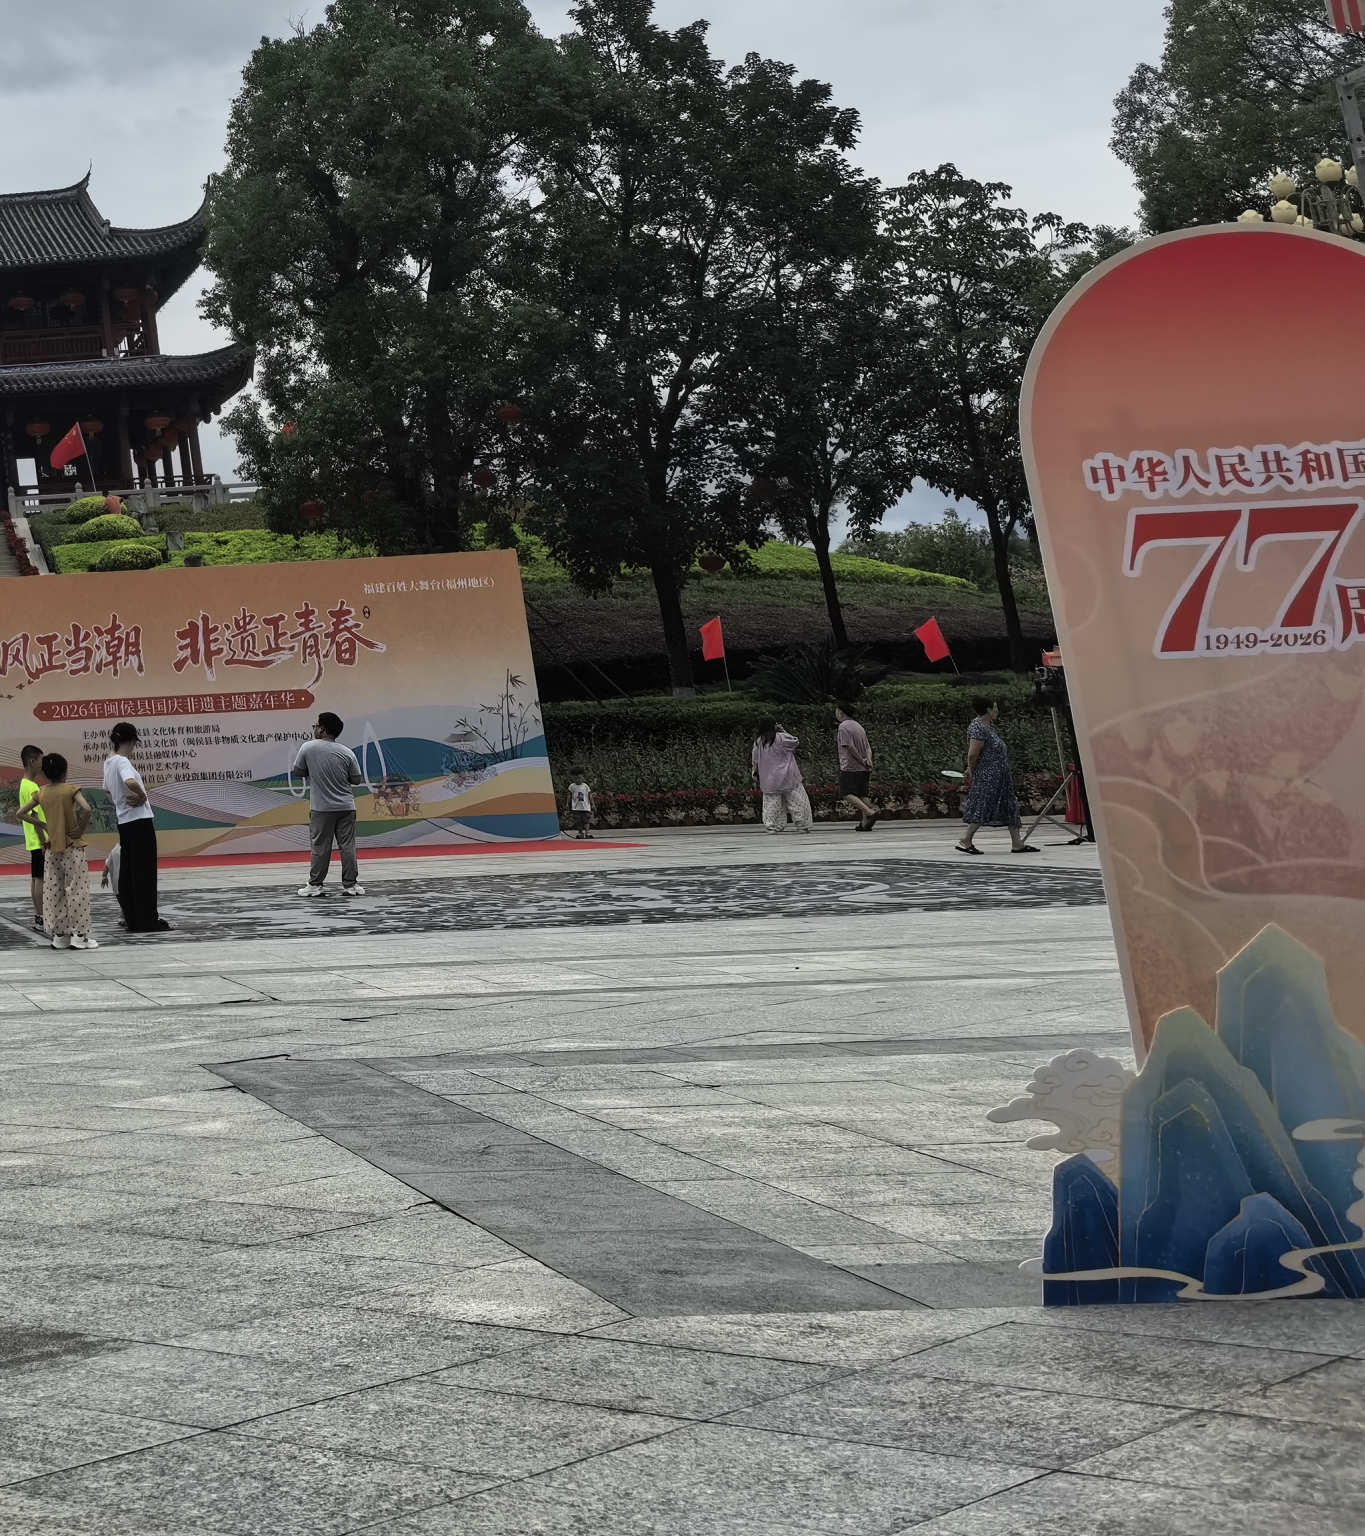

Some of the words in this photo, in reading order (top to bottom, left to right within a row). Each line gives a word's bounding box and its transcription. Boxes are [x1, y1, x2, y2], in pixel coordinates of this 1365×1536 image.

[1090, 447, 1365, 495] 中华人民共和国
[363, 577, 495, 595] 福建百姓大舞台(福州地区)
[172, 599, 387, 689] 非遗正青春
[1203, 629, 1327, 651] 1949-2026
[51, 692, 296, 719] 2026年闽侯县国庆非遗主题嘉年华
